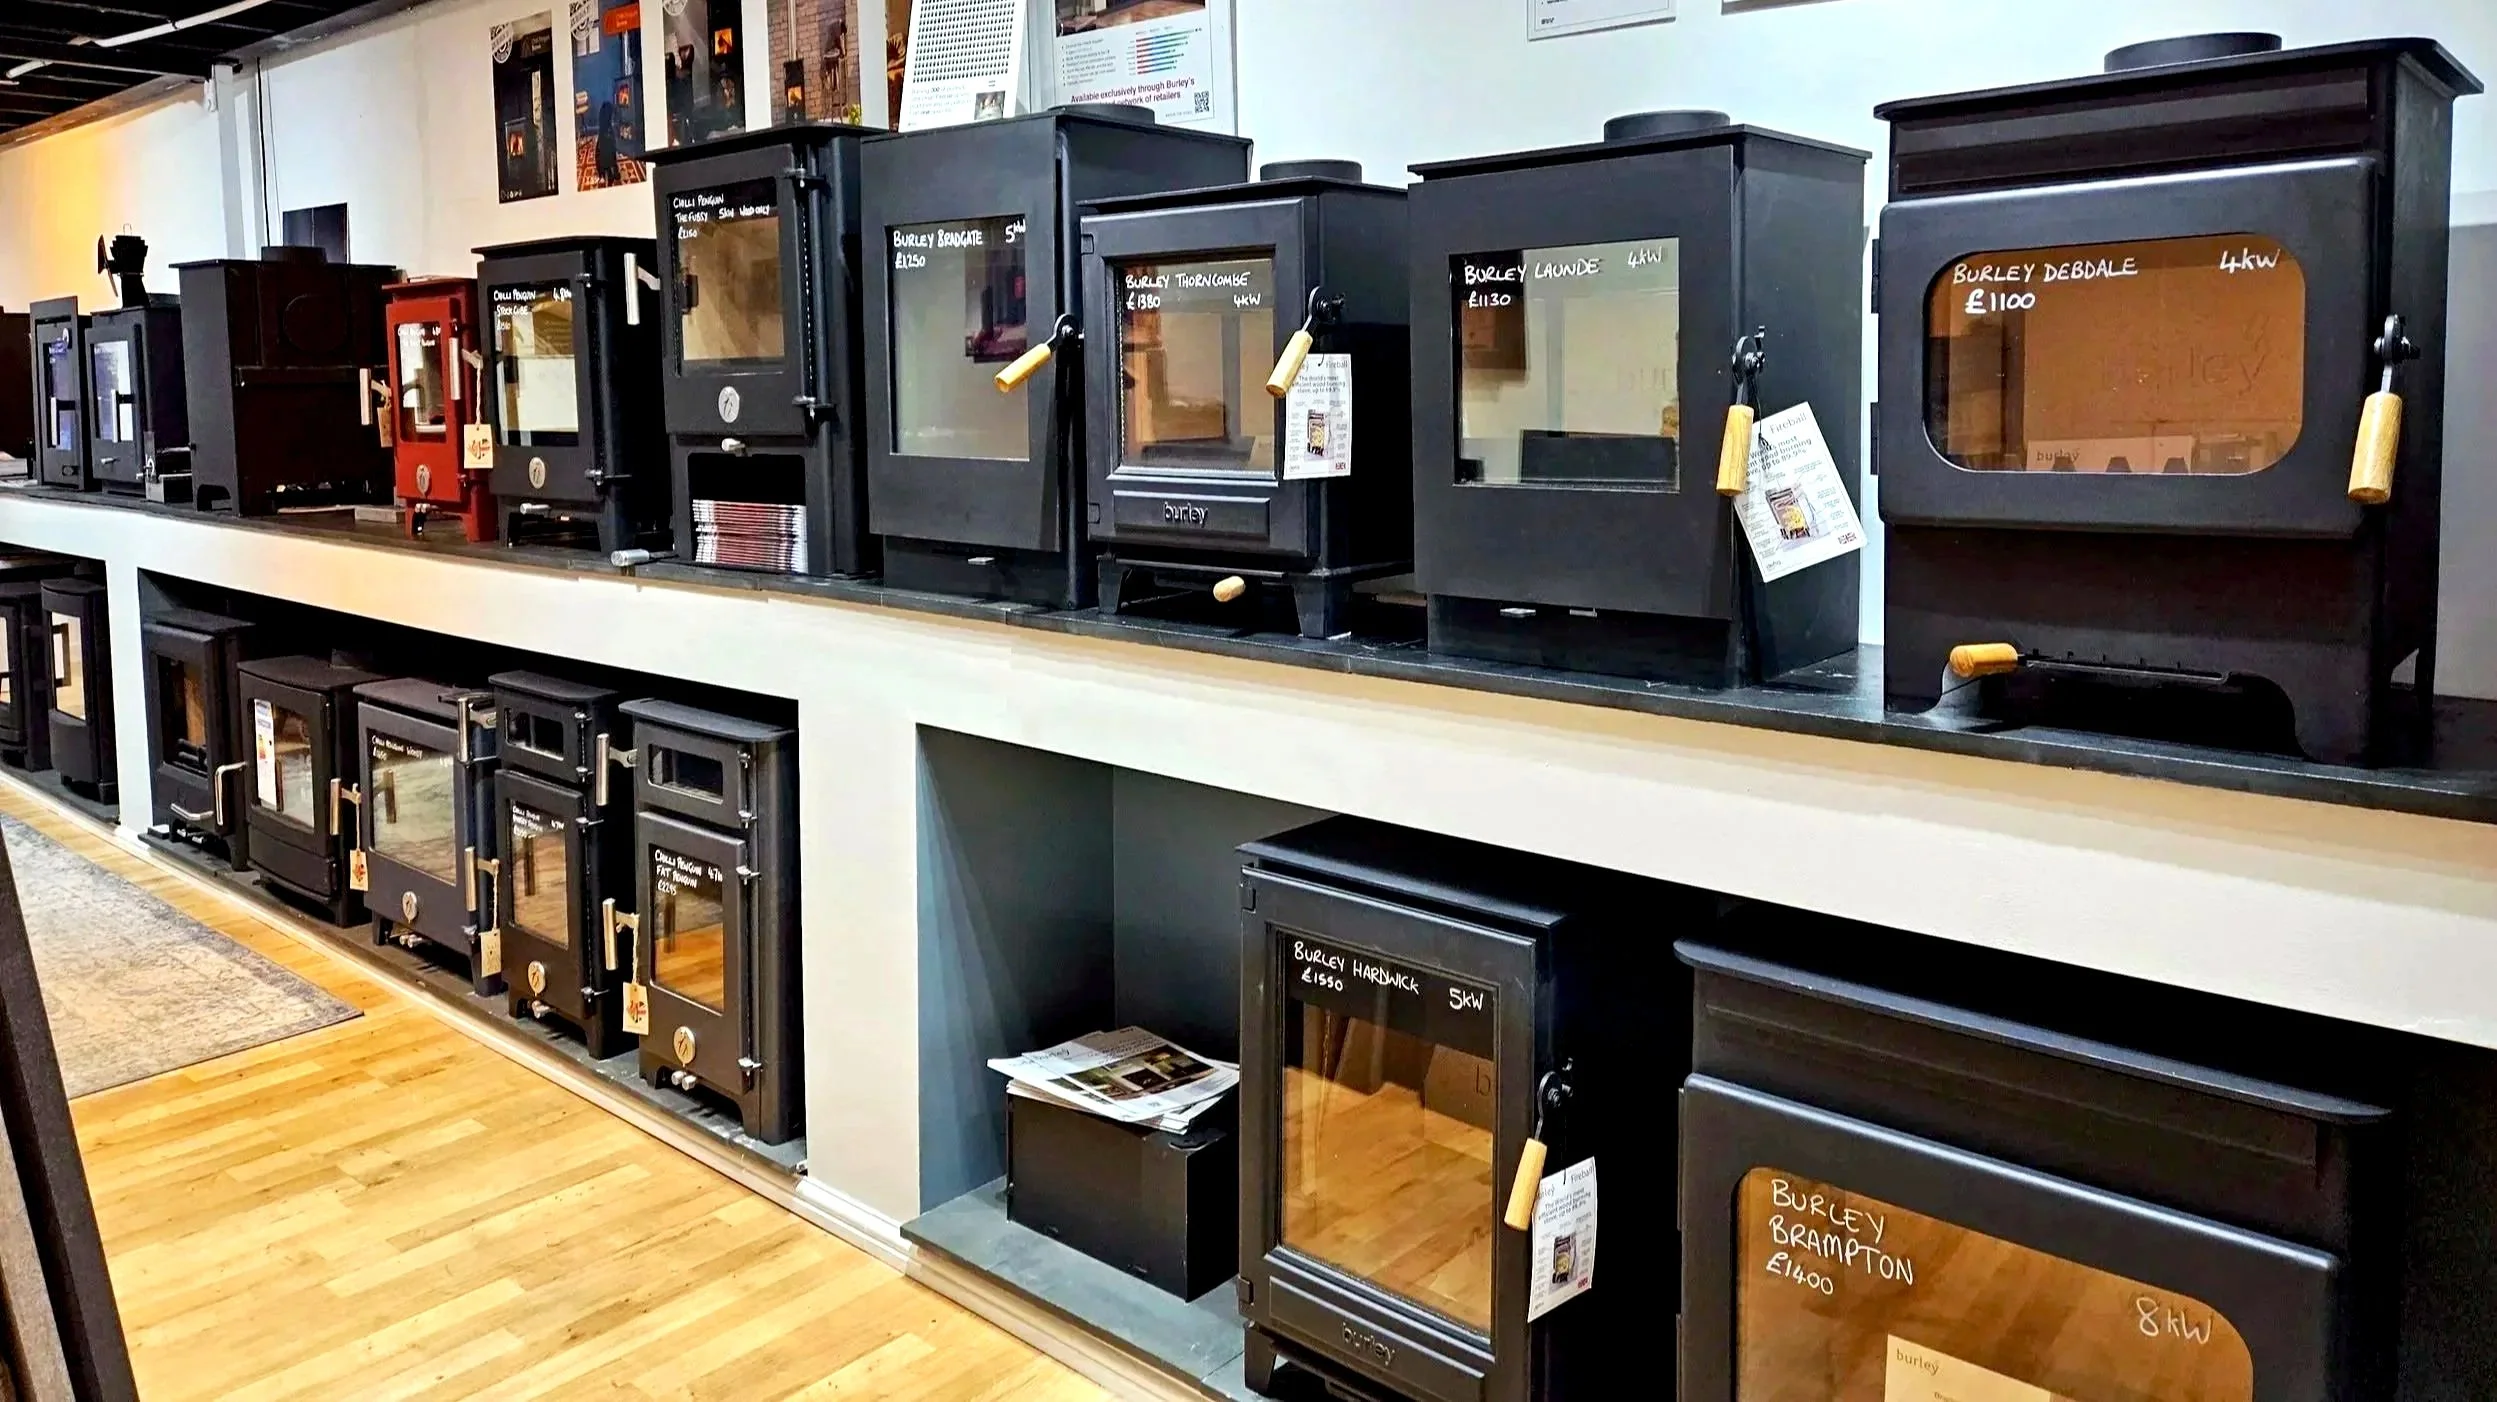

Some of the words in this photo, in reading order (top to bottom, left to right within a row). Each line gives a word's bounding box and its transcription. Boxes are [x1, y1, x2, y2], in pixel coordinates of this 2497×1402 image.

[1071, 92, 1100, 104] Available
[1100, 86, 1137, 101] exclusively
[1138, 82, 1165, 97] through
[1166, 76, 1195, 92] Burley's
[1152, 90, 1182, 103] retailers
[894, 230, 934, 248] BURLEY
[937, 228, 984, 248] BRADGATE
[895, 251, 926, 269] £1250
[1464, 263, 1526, 285] BURLEY
[1534, 258, 1601, 279] LAUNDE
[1953, 262, 2035, 285] BURLEY
[2043, 257, 2139, 283] DEBDALE
[1125, 274, 1169, 289] BURLEY
[1175, 271, 1251, 289] THORNCOMBE
[1126, 291, 1161, 310] £1380
[1468, 290, 1511, 308] £1130
[1965, 287, 2036, 315] £1100
[1769, 412, 1807, 434] Fireball
[1163, 500, 1208, 528] burley
[1293, 940, 1345, 973] BURLEY
[1352, 959, 1420, 996] HARDWICK
[1301, 966, 1344, 992] £1550
[1770, 1178, 1885, 1245] BURLEY
[1768, 1213, 1914, 1287] BRAMPTON
[1765, 1251, 1834, 1296] £1400
[1342, 1320, 1396, 1368] burley
[1896, 1347, 1940, 1377] burley
